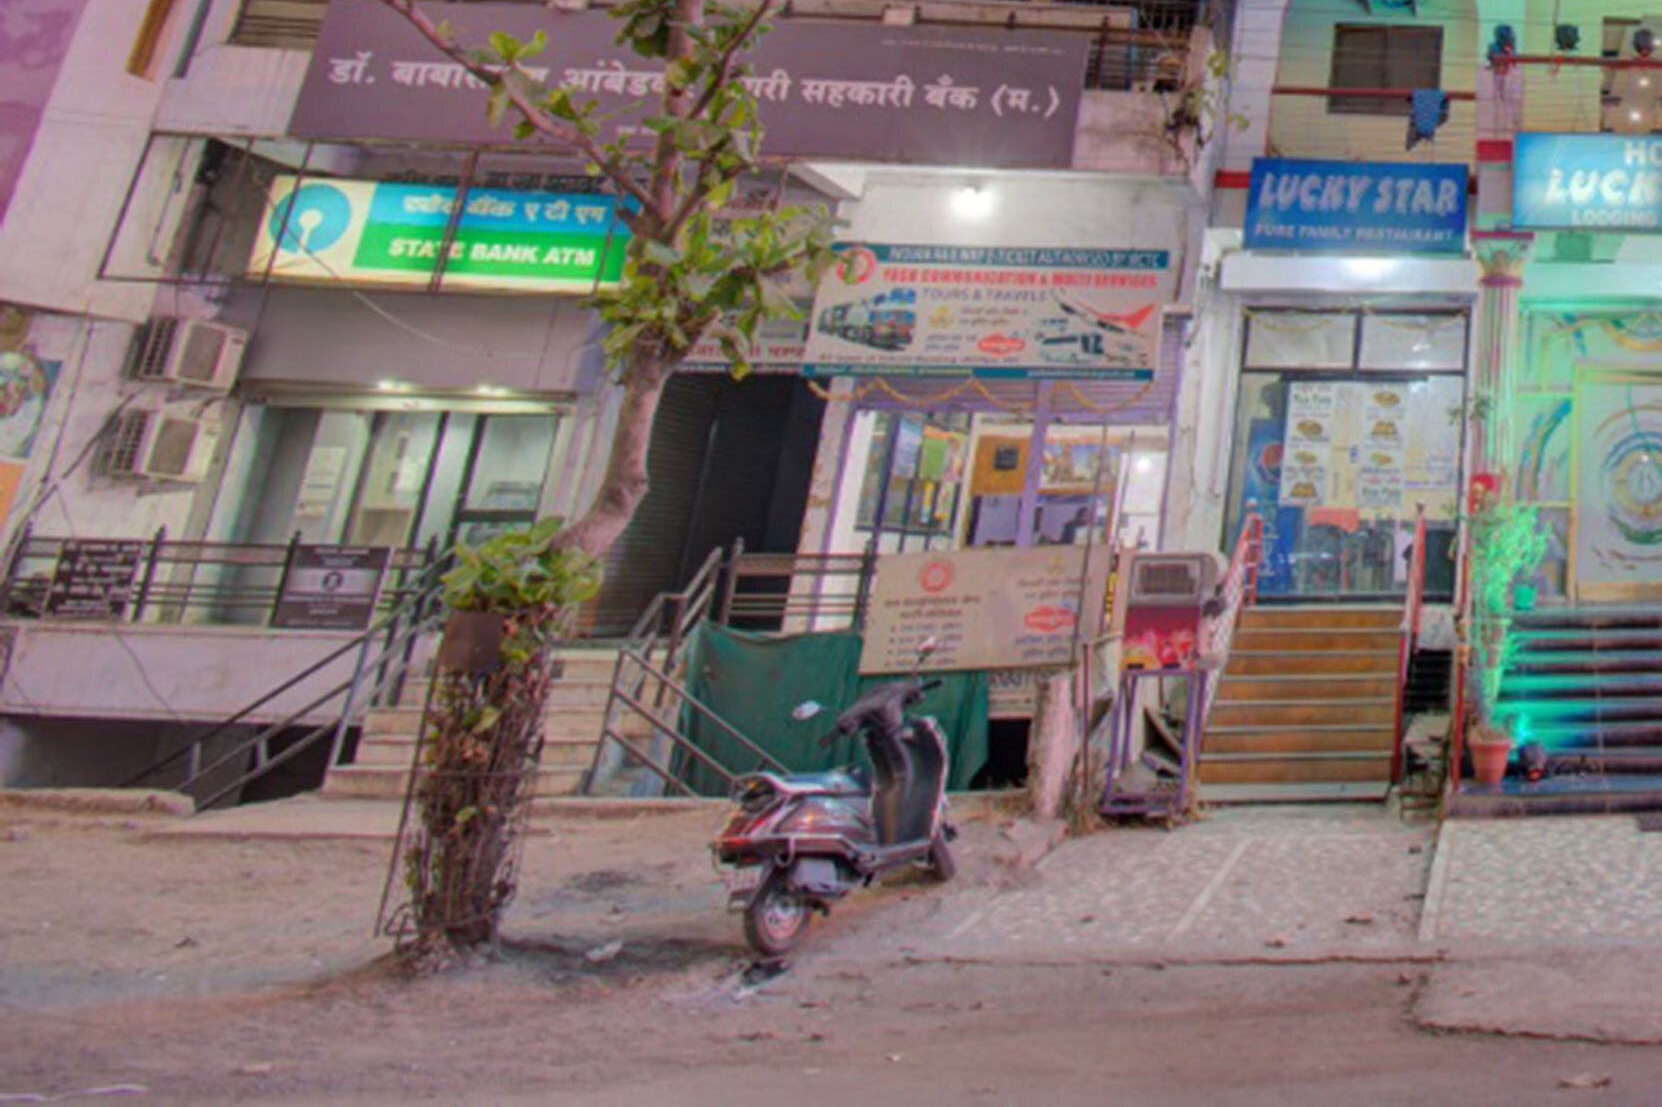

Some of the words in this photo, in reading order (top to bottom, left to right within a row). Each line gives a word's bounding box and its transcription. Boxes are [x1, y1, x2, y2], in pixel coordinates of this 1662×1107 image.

[328, 50, 377, 86] डॉ.
[800, 75, 917, 109] सहकारी
[1260, 172, 1372, 214] LUCKY
[1374, 176, 1460, 217] STAR
[1571, 209, 1658, 227] LODGING
[1256, 222, 1296, 238] PURE
[1300, 225, 1351, 240] FAMILY
[470, 243, 539, 264] BANK
[543, 249, 596, 267] ATM
